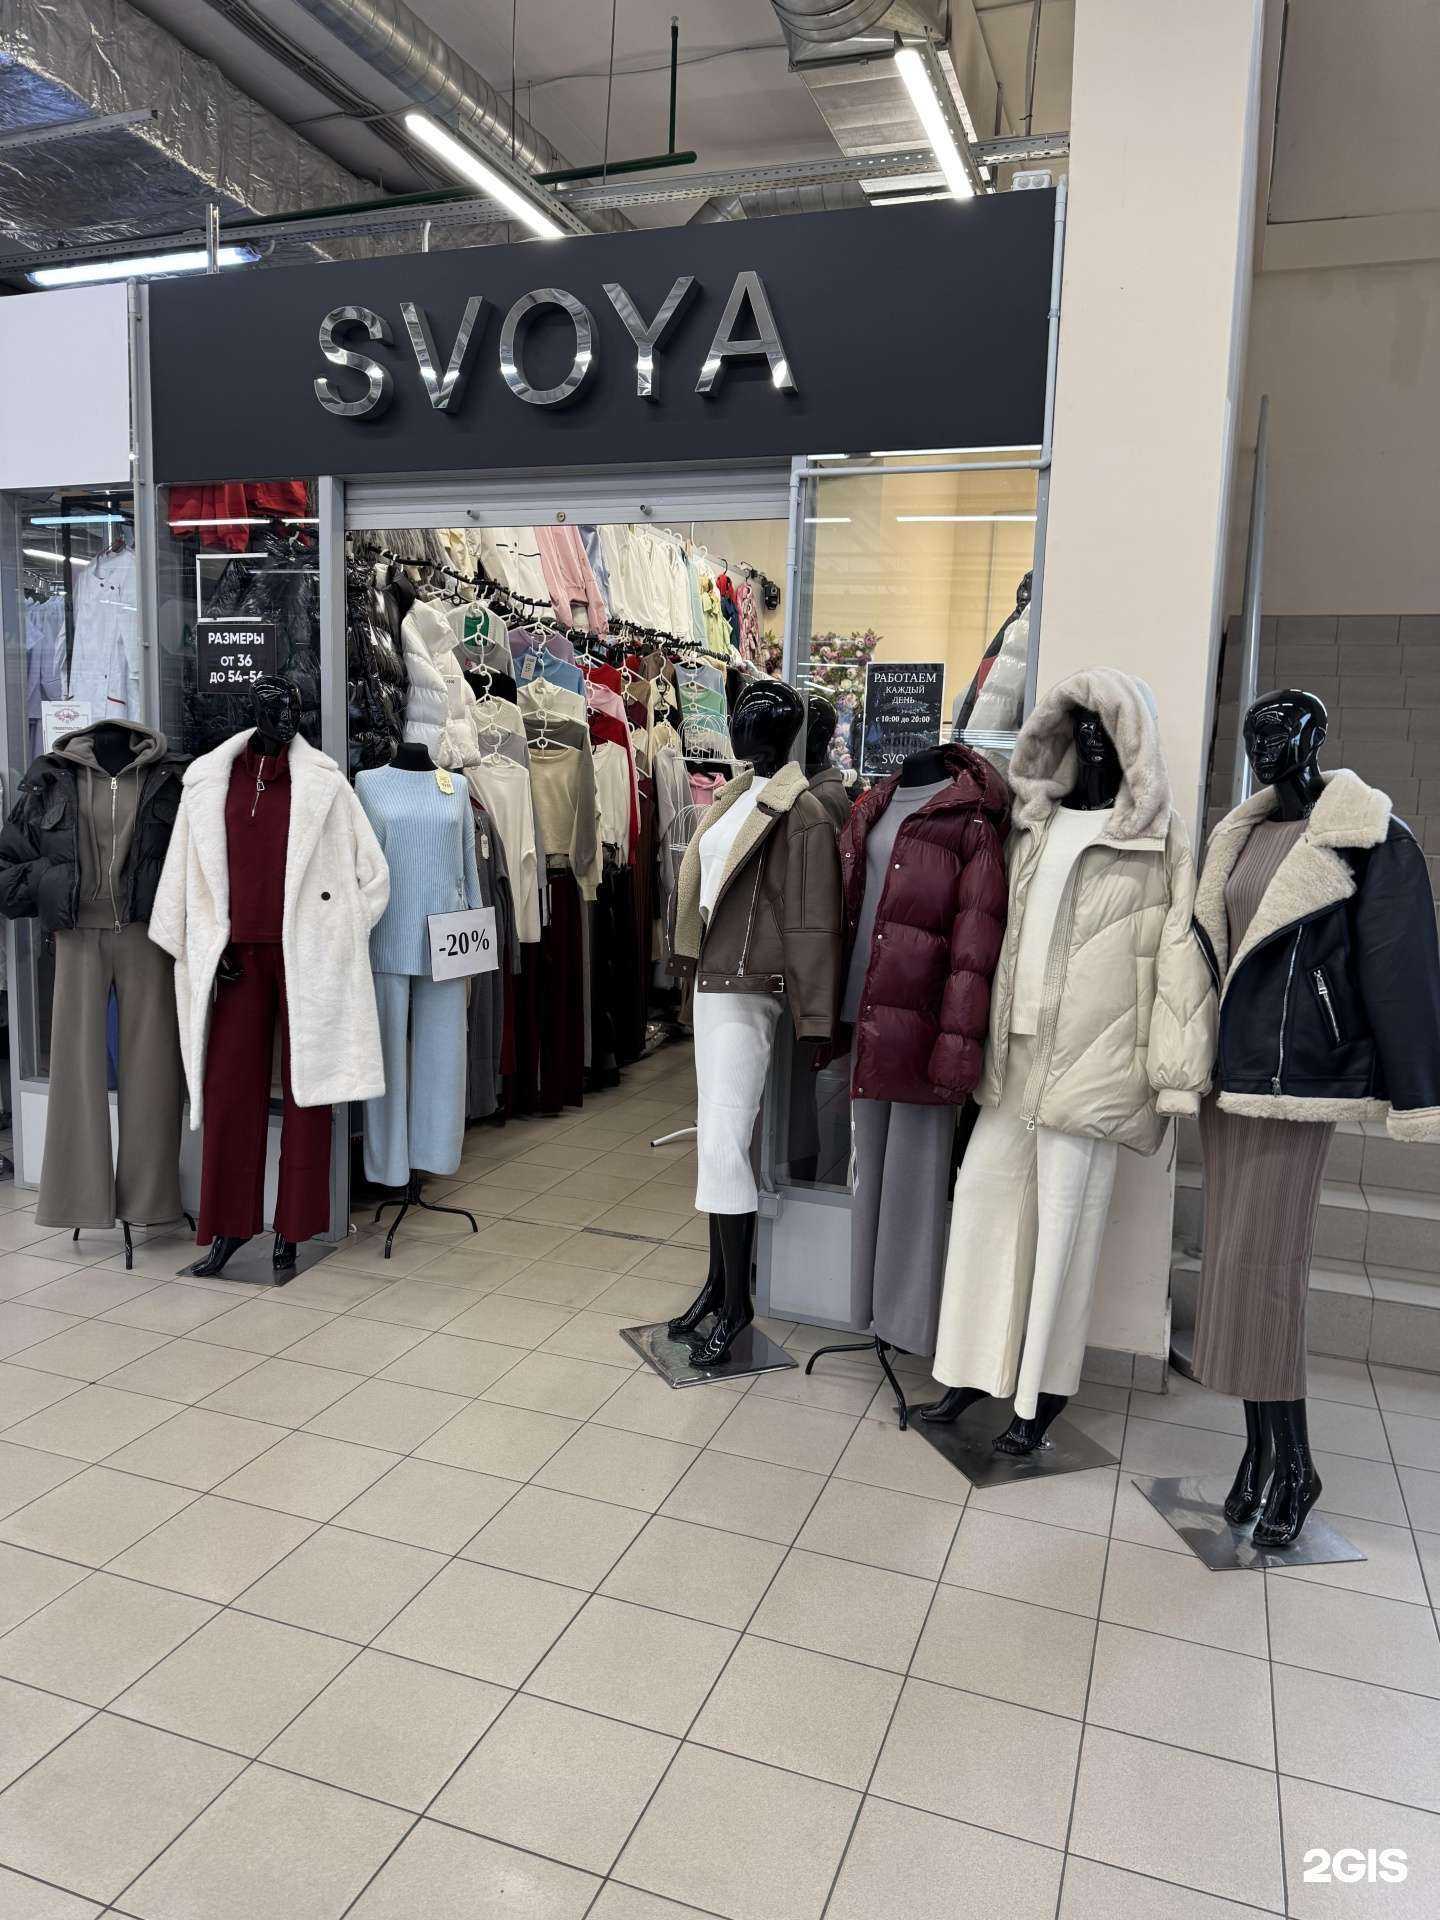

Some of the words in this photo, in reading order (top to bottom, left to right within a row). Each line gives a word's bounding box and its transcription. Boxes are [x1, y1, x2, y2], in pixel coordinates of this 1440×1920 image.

[313, 270, 799, 417] SVOYA
[208, 632, 265, 645] РАЗМЕРЫ
[237, 654, 253, 667] 36
[873, 672, 937, 683] РАБОТАЕМ
[886, 685, 925, 694] КАЖДЫЙ
[892, 696, 915, 705] ДЕНЬ
[881, 715, 900, 723] 10:00
[910, 715, 930, 723] 20:00
[881, 753, 908, 765] SVO
[438, 929, 489, 957] -20%
